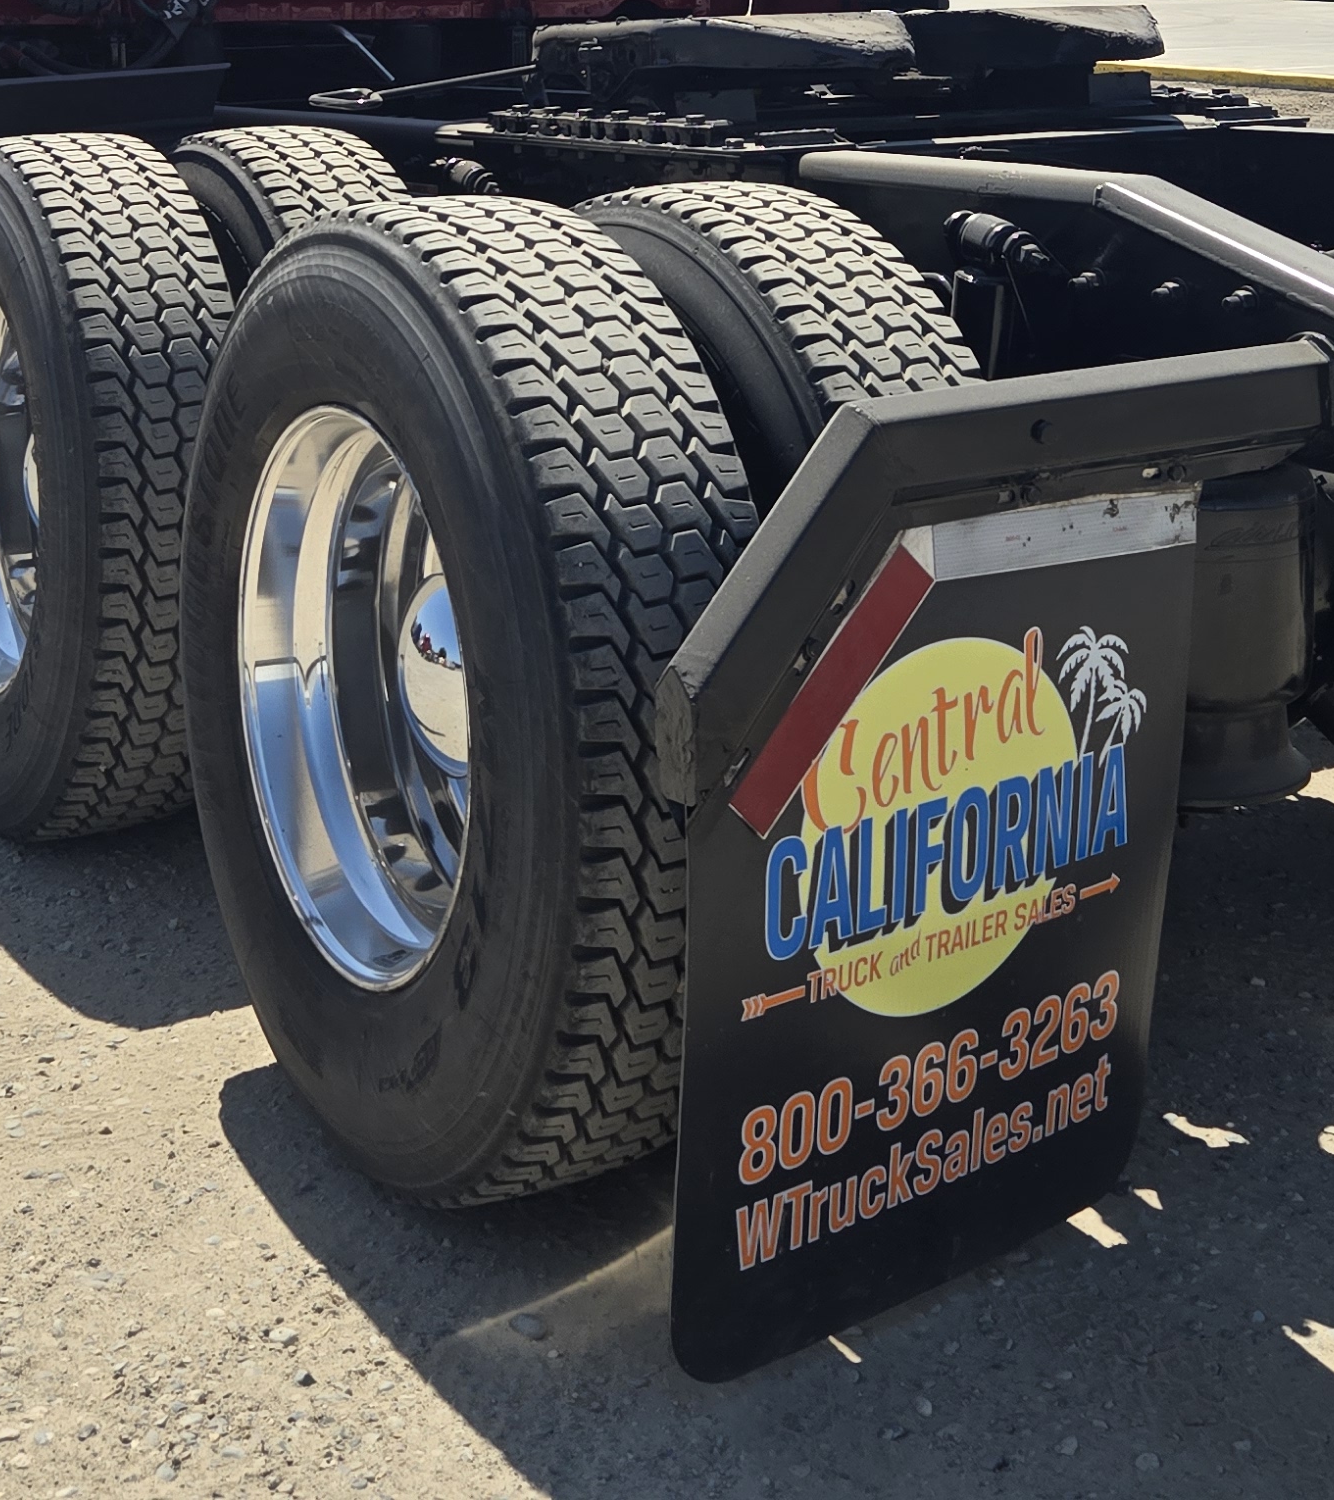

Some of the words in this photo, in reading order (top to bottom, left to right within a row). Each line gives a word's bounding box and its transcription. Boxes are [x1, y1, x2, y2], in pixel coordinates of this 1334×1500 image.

[802, 626, 1045, 834] Central
[765, 743, 1128, 961] CALIFORNIA
[806, 951, 883, 1003] TRUCK
[889, 929, 922, 977] and
[925, 909, 1008, 962] TRAILER
[1013, 884, 1076, 926] SALES
[735, 1053, 1111, 1271] WTruckSales.net
[738, 969, 1120, 1185] 800-366-3263
